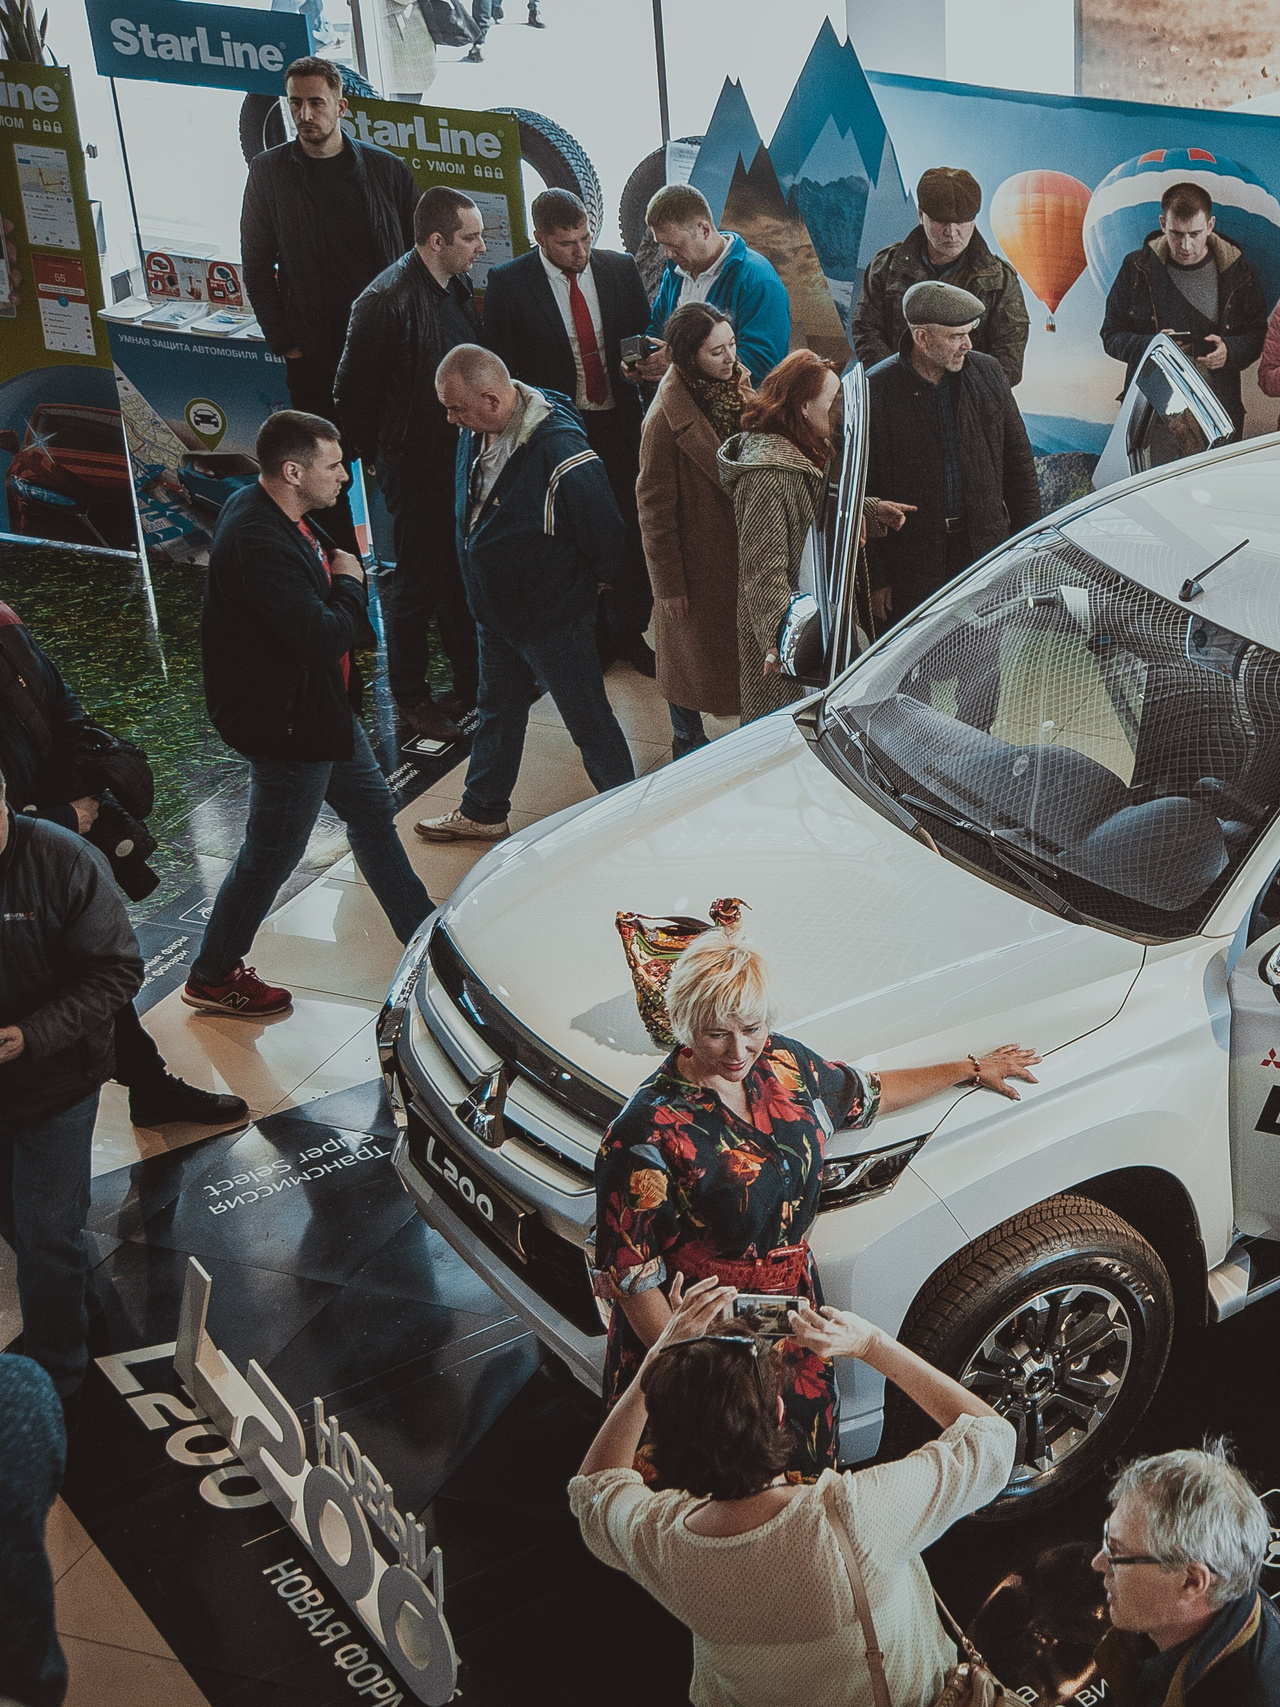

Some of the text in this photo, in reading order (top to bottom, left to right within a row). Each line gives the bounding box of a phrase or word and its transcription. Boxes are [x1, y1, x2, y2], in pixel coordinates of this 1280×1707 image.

[110, 18, 285, 72] StarLine
[0, 71, 59, 113] ine
[426, 159, 466, 175] УМОМ
[117, 333, 258, 361] УМНАЯ ЗАЩИТА АВТОМОБИЛЯ
[151, 949, 190, 977] фонари
[161, 935, 190, 956] фары
[203, 1130, 375, 1197] Super Select
[208, 1145, 391, 1215] Трансмиссия
[426, 1135, 494, 1222] L200
[262, 1558, 351, 1647] НОВАЯ
